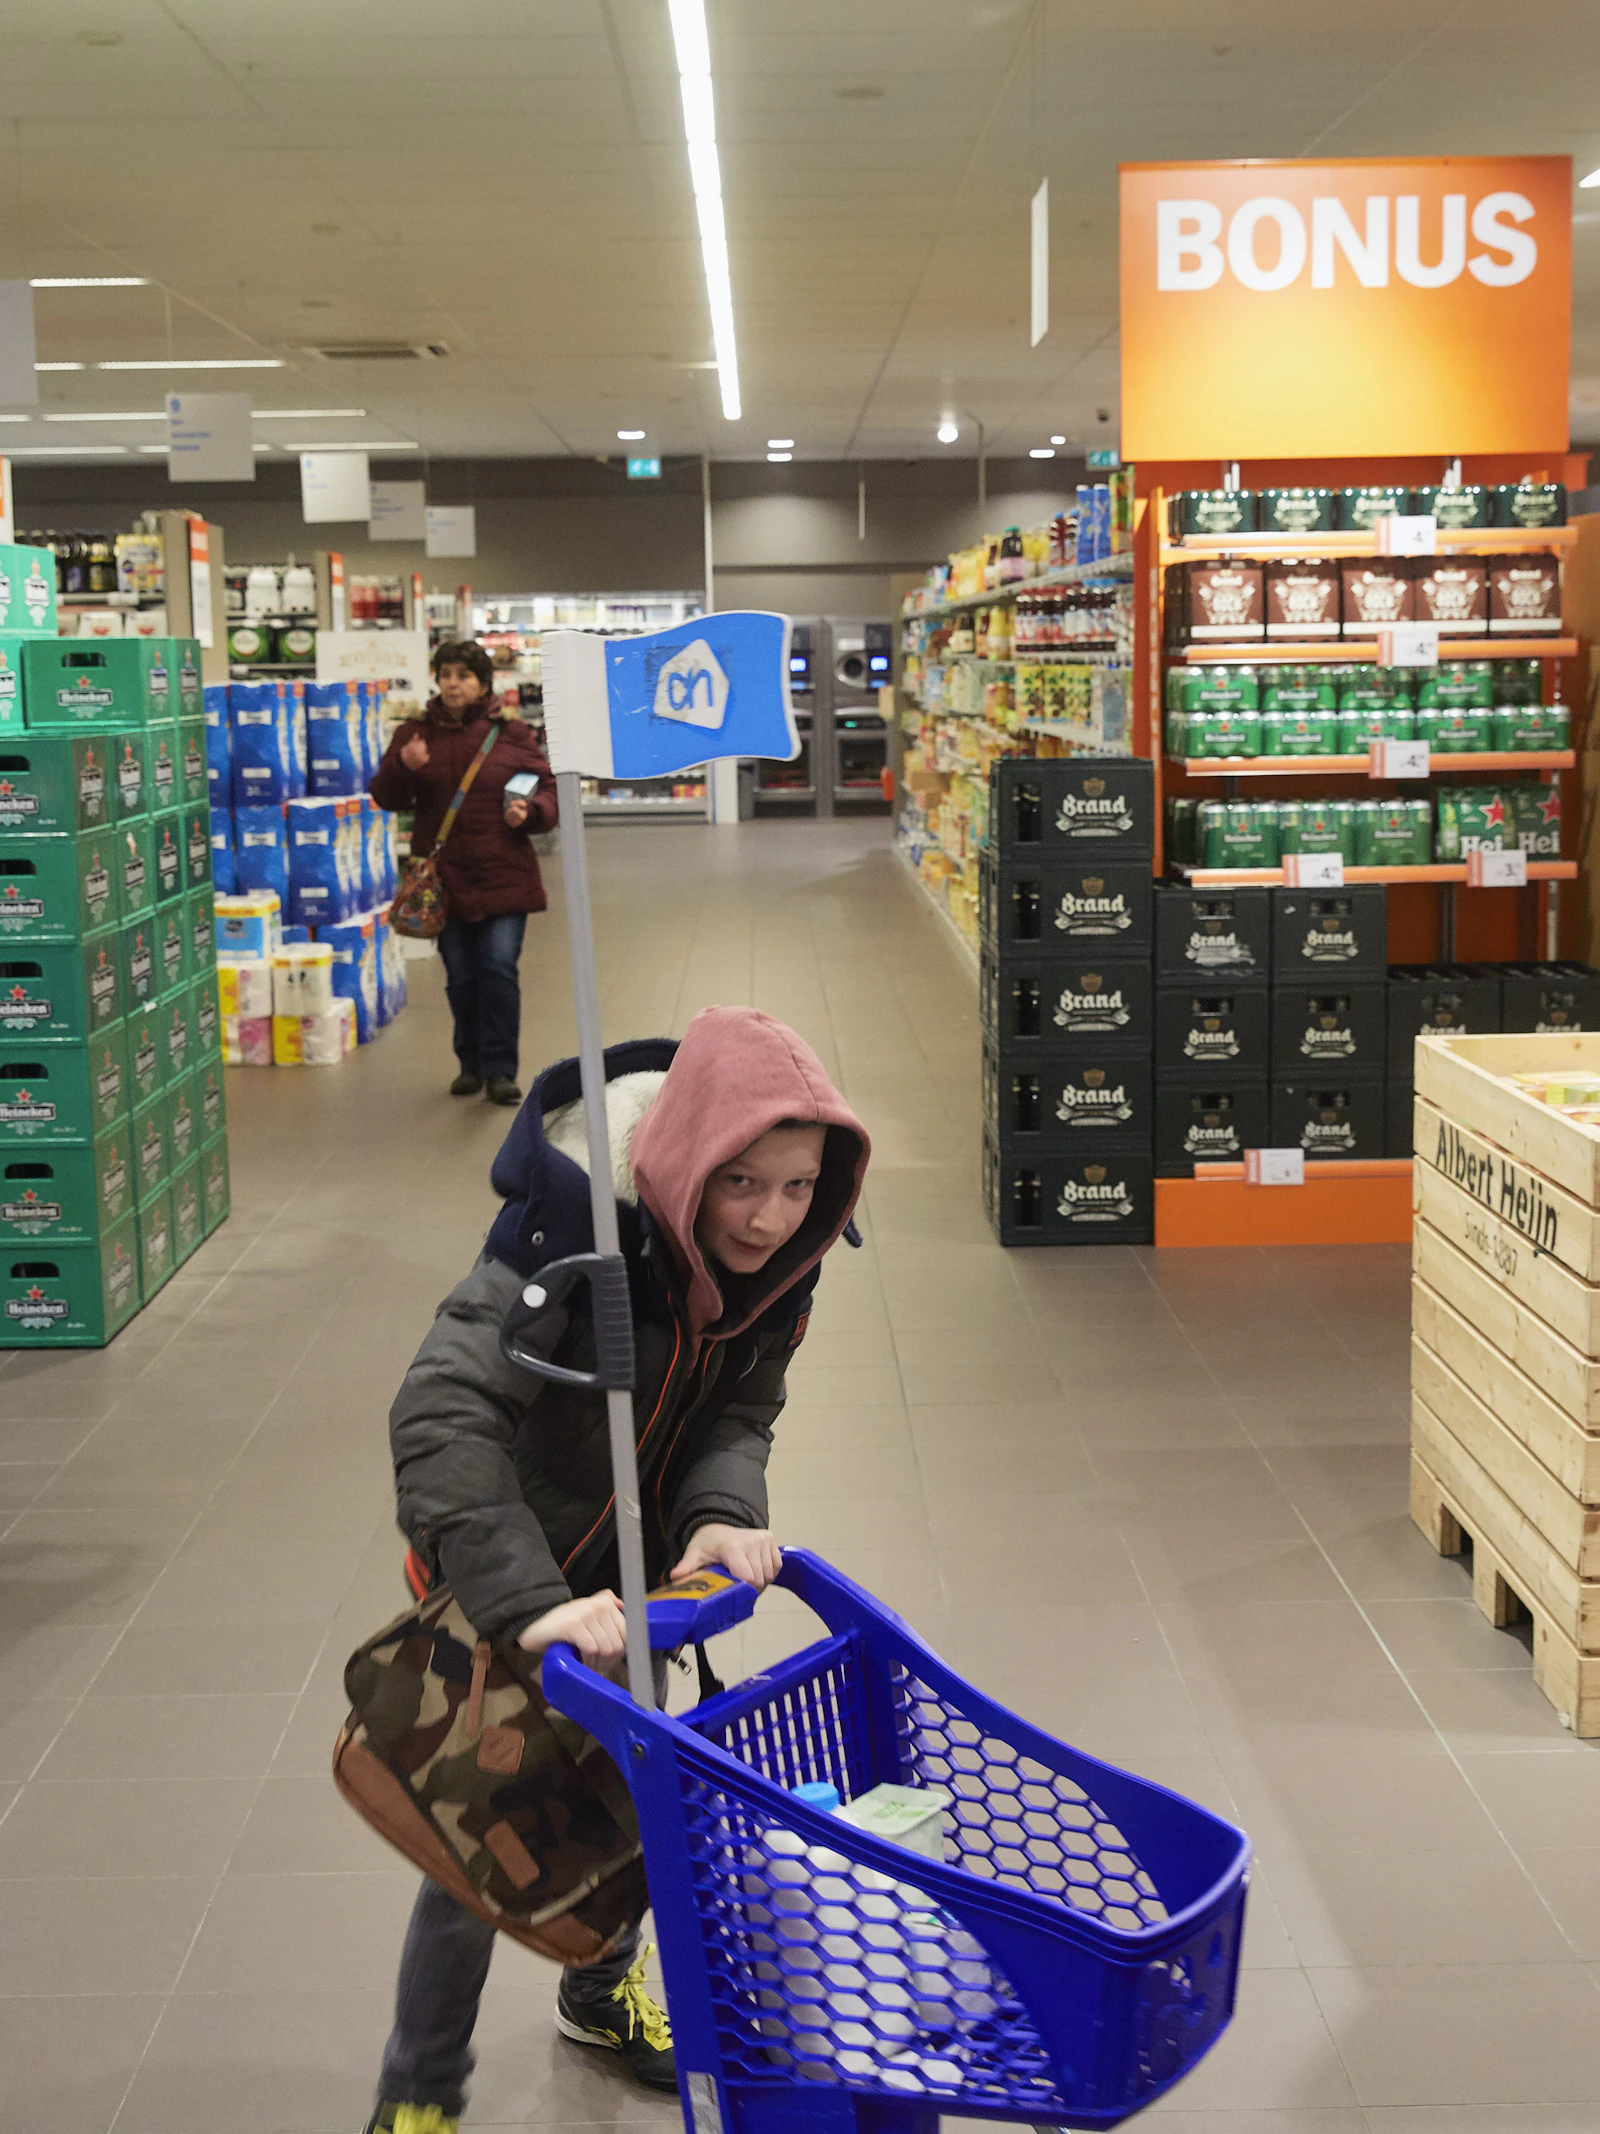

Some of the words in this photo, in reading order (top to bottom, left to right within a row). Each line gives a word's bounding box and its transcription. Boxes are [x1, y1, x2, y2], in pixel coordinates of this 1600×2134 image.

[1157, 191, 1538, 291] BONUS
[1062, 793, 1126, 817] Brand
[1518, 830, 1560, 853] Hei
[1061, 892, 1125, 915] Brand
[1190, 932, 1236, 949] Brand
[1307, 929, 1354, 946] Brand
[0, 1001, 47, 1015] eineken
[1060, 989, 1123, 1012] Brand
[1188, 1028, 1235, 1046] Brand
[1305, 1026, 1351, 1044] Brand
[1062, 1084, 1126, 1107] Brand
[1188, 1124, 1235, 1141] Brand
[1305, 1121, 1351, 1138] Brand
[1064, 1180, 1127, 1203] Brand
[1436, 1118, 1494, 1206] Albert
[1500, 1159, 1558, 1258] Heijn
[4, 1205, 58, 1218] Heineken
[8, 1301, 65, 1315] Heineken
